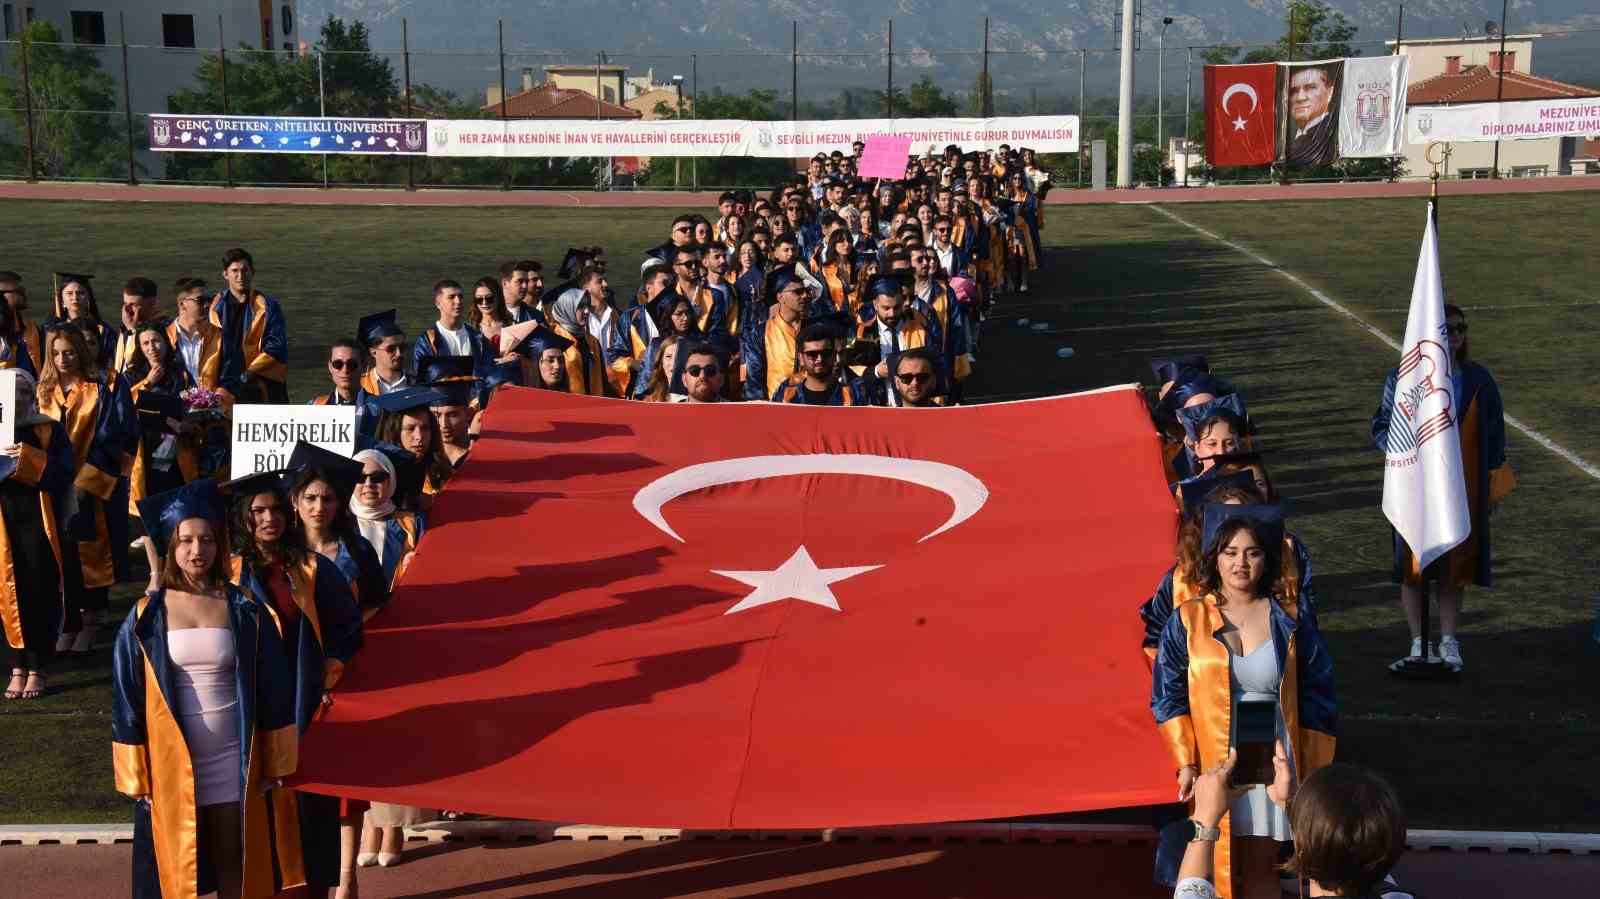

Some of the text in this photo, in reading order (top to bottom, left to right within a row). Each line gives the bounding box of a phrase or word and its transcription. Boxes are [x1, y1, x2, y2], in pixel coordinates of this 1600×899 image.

[1540, 104, 1600, 119] MEZUNİYE
[176, 120, 213, 132] GENÇ,
[215, 119, 272, 131] ÜRETKEN,
[334, 120, 401, 133] ÜNİVERSİTE
[1482, 120, 1575, 136] DİPLOMALARINIZ
[459, 133, 478, 144] HER
[481, 133, 515, 144] ZAMAN
[519, 131, 561, 144] KENDİNE
[564, 131, 588, 144] İNAN
[591, 133, 603, 144] VE
[605, 130, 667, 144] HAYALLERİNİ
[777, 132, 813, 145] SEVGİLİ
[975, 131, 1009, 141] GURUR
[1012, 129, 1073, 140] DUYMALISIN
[237, 418, 351, 448] HEMŞİRELİK
